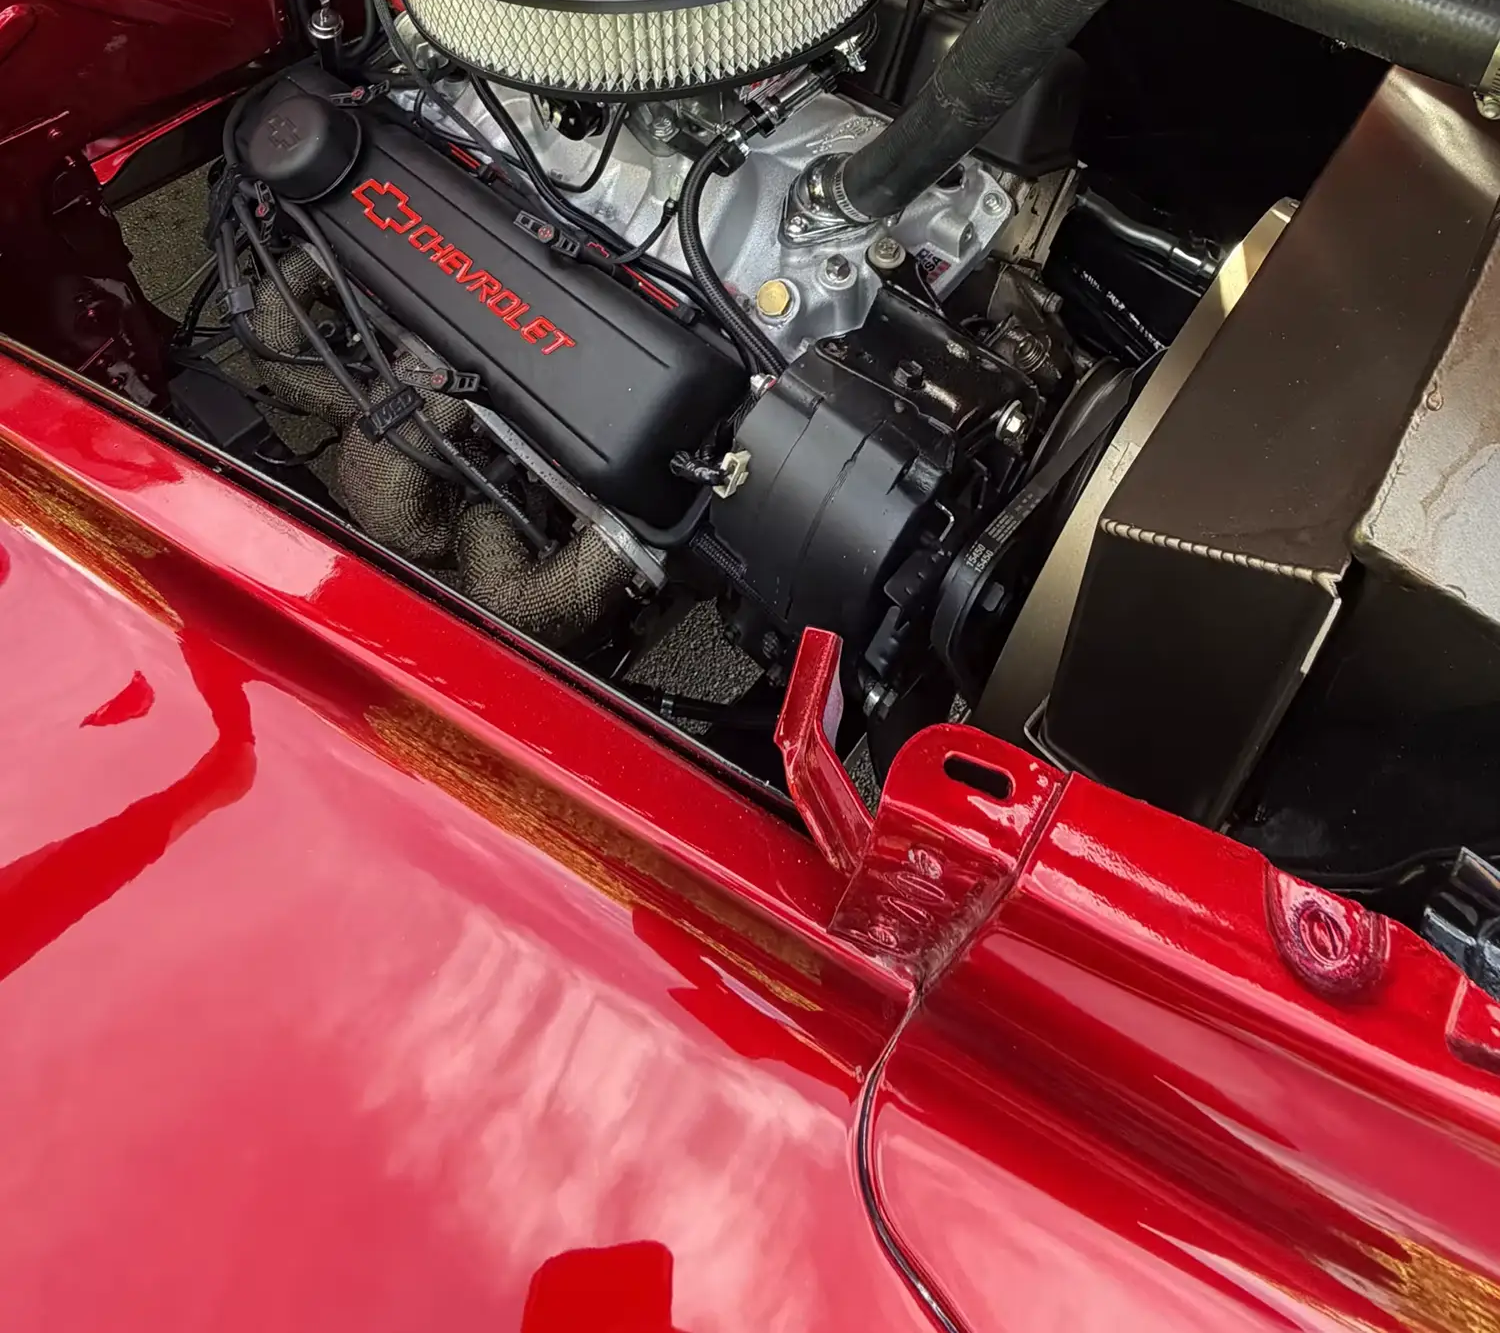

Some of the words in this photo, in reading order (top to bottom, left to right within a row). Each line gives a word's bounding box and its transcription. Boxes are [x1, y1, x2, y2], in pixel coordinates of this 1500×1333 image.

[407, 224, 577, 356] CHEVROLET
[965, 543, 986, 568] 15450
[973, 549, 995, 574] 15450
